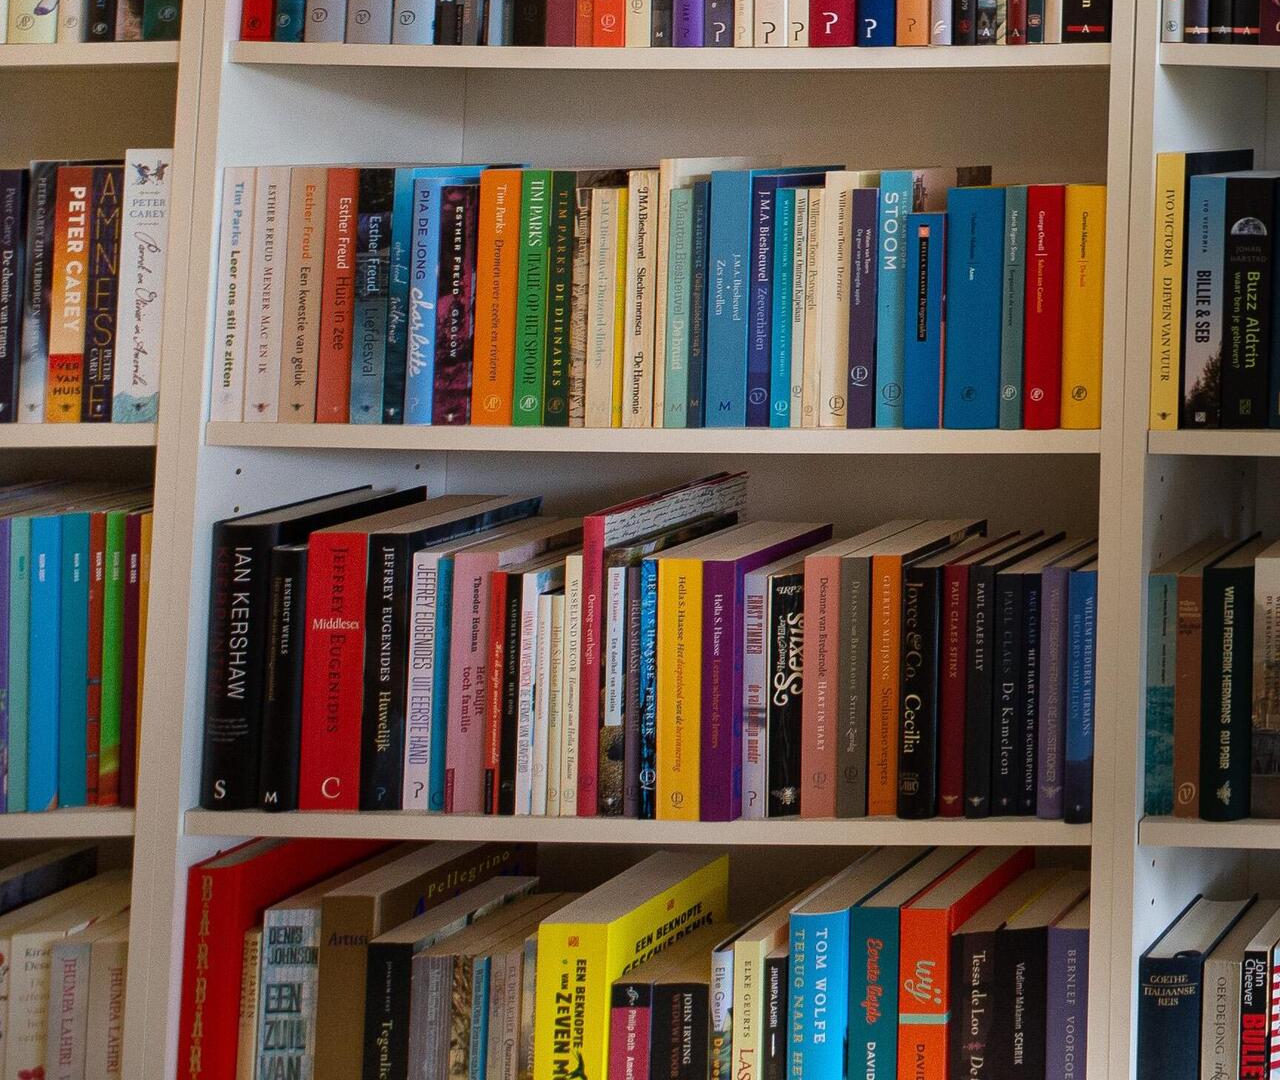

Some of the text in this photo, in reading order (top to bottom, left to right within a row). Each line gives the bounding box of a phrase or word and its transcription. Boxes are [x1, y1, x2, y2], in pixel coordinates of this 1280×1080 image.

[367, 216, 383, 253] Esther
[528, 180, 544, 246] TIM PARKS
[883, 192, 900, 269] STOOM
[64, 186, 86, 331] PETER CAREY
[366, 258, 380, 292] Freud
[1194, 270, 1212, 343] BILLIE & SEB
[1244, 271, 1260, 368] Buzz Aldrin
[226, 547, 252, 699] IAN KERSHAW
[903, 695, 920, 753] Cecilia
[554, 992, 573, 1054] ZEVEN
[573, 959, 587, 1048] EEN BEKNOPTE
[813, 929, 828, 1043] TOM WOLFE
